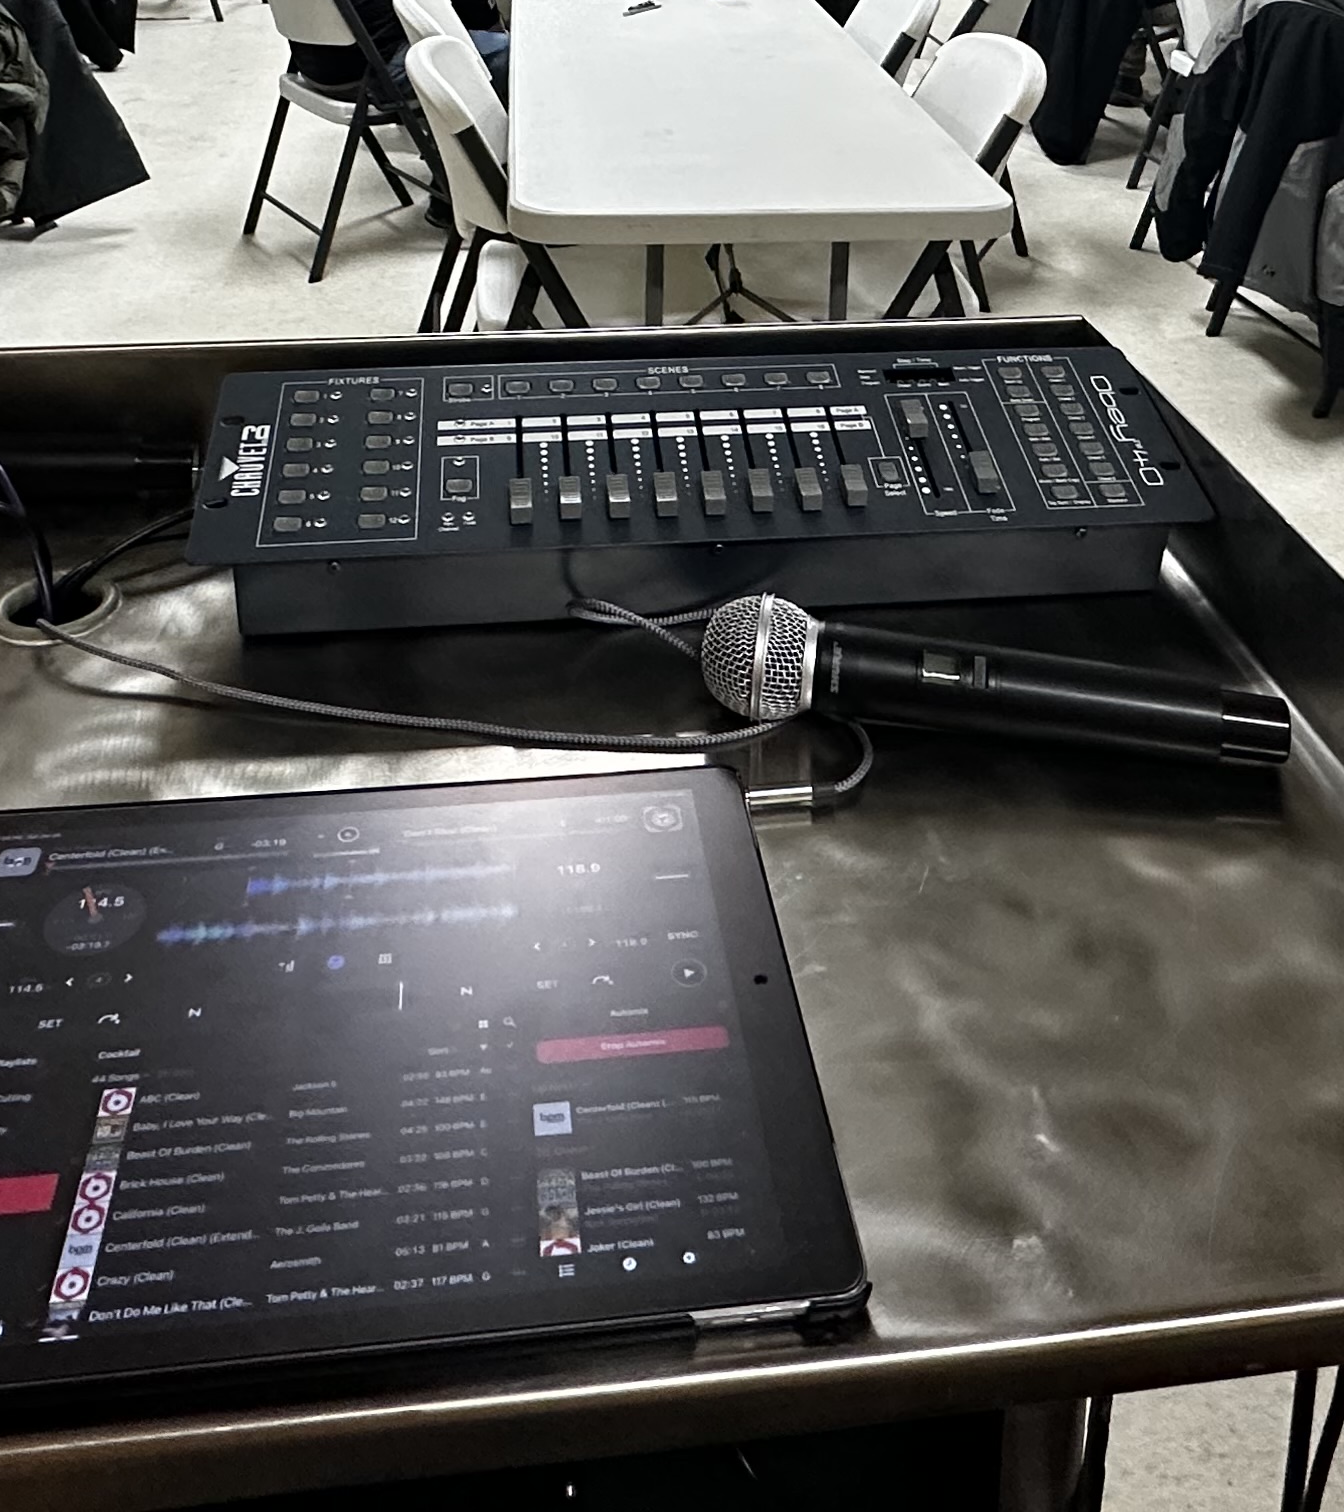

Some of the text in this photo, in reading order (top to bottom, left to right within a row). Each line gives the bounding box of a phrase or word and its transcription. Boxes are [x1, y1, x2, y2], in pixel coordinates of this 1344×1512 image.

[648, 366, 689, 374] SCENES
[328, 377, 379, 385] FIXTURES
[231, 442, 267, 497] CHAUVET
[49, 850, 105, 860] Centerfold
[108, 848, 148, 858] (Clean)
[78, 896, 124, 909] 14.5
[38, 1019, 64, 1029] SET
[98, 1049, 140, 1060] Cocktail
[139, 1094, 161, 1103] ABC
[164, 1092, 200, 1103] (Clean)
[169, 1119, 193, 1128] Love
[197, 1116, 218, 1126] Your
[221, 1115, 242, 1124] Way
[158, 1148, 172, 1157] Of
[174, 1145, 212, 1155] Burden
[214, 1141, 252, 1153] (Clean)
[624, 1166, 658, 1176] Burden
[120, 1179, 146, 1190] Brick
[187, 1172, 224, 1184] (Clean)
[646, 1199, 681, 1210] (Clean)
[112, 1209, 164, 1220] California
[167, 1204, 205, 1217] (Clean)
[105, 1241, 164, 1252] Centerfold
[167, 1237, 206, 1247] (Clean)
[275, 1227, 294, 1236] The
[97, 1276, 130, 1286] Crazy
[133, 1270, 174, 1284] (Clean)
[89, 1309, 121, 1322] Don't
[124, 1307, 140, 1318] Do
[143, 1305, 161, 1316] Me
[164, 1302, 188, 1314] Like
[191, 1300, 216, 1311] That
[266, 1294, 288, 1304] Tom
[290, 1292, 316, 1302] Petty
[320, 1290, 328, 1298] &
[331, 1287, 351, 1296] The
[449, 1273, 473, 1284] BPM
